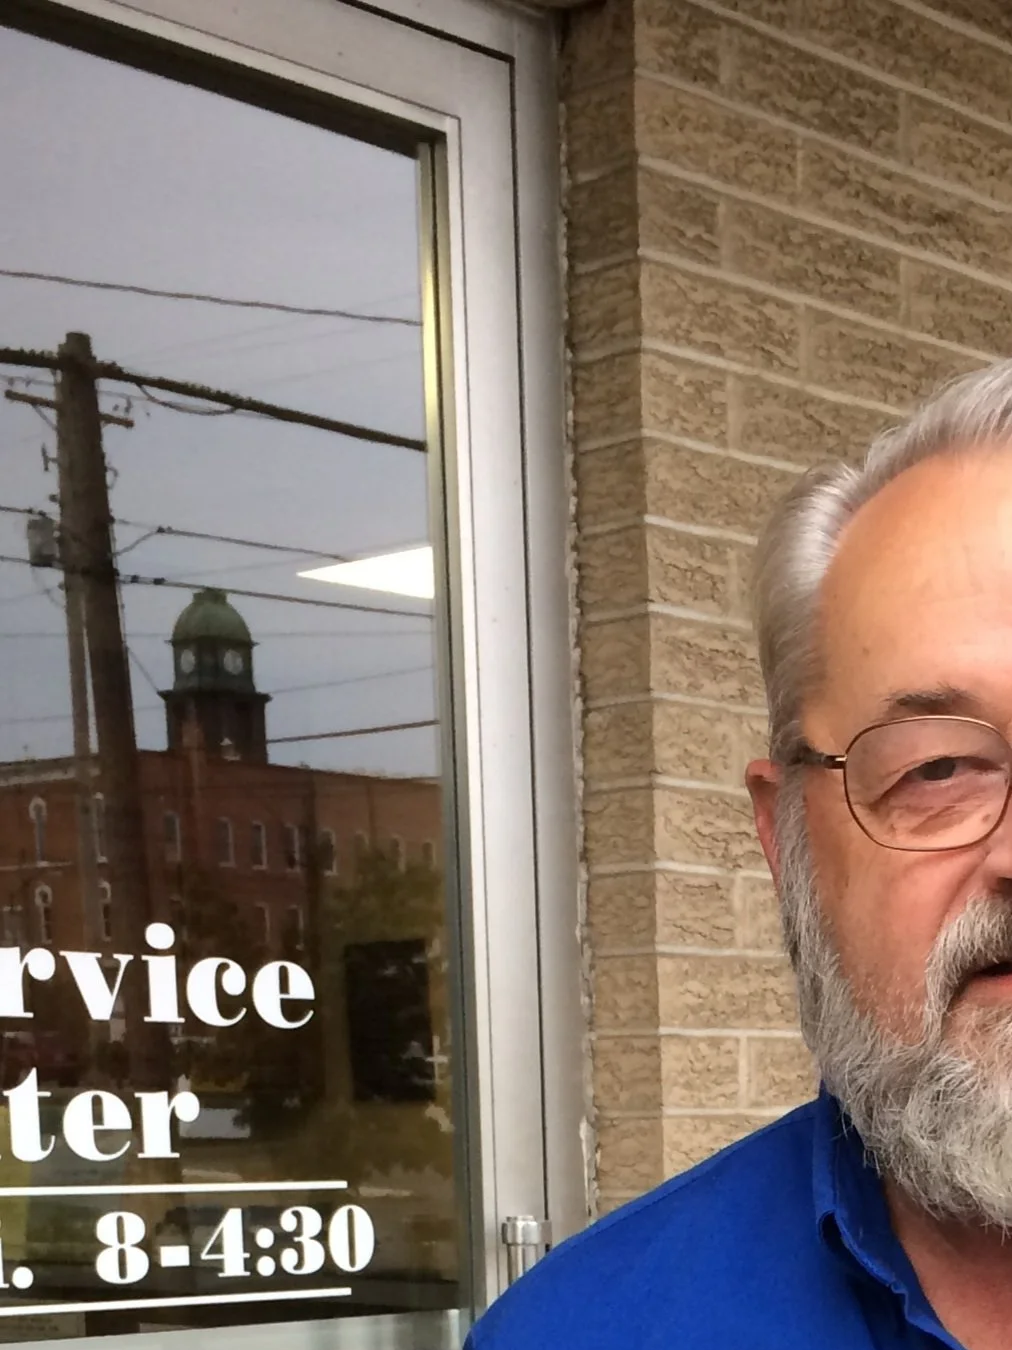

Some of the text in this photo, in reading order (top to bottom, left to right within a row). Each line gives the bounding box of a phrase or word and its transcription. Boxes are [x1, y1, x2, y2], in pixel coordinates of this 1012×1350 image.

[0, 922, 316, 1029] rvice
[2, 1066, 201, 1162] ter
[95, 1203, 376, 1285] 8-4:30
